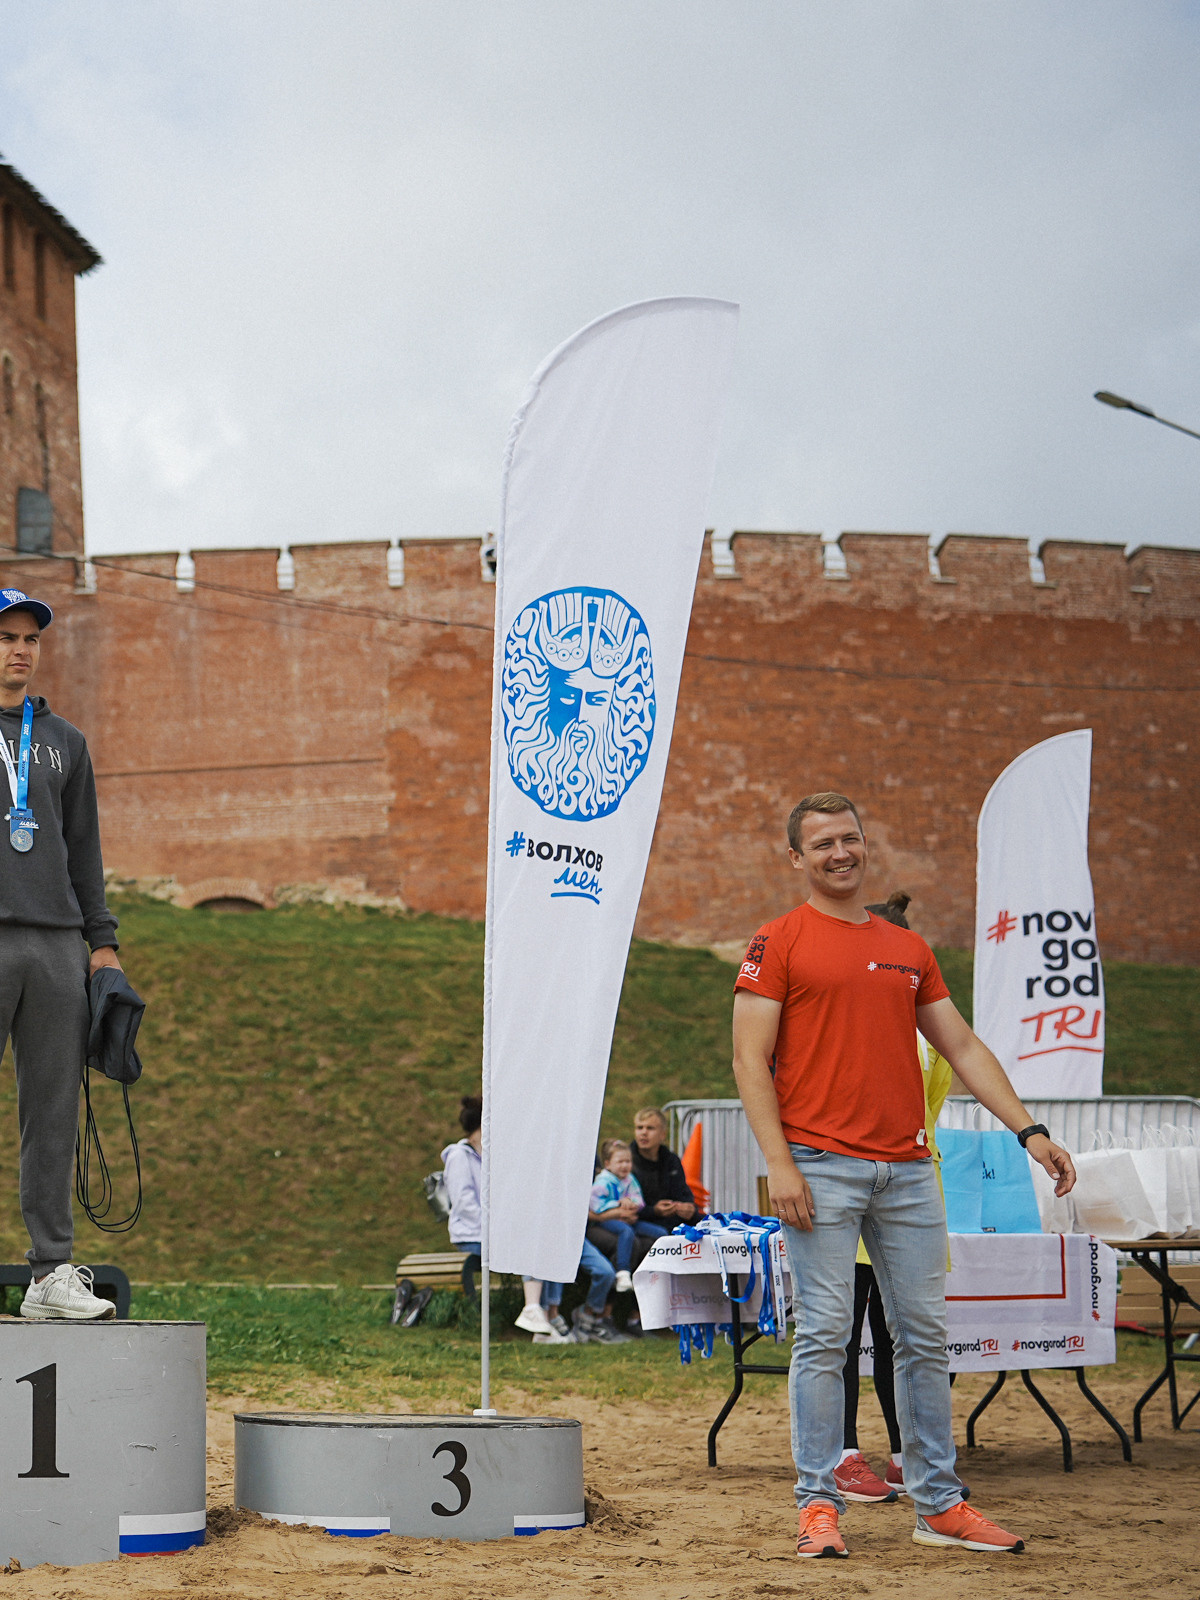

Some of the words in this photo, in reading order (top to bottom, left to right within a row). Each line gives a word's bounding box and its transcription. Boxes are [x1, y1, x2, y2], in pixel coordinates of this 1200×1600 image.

[986, 909, 1092, 944] #nov
[1042, 938, 1096, 971] go
[1026, 962, 1099, 999] rod
[1021, 1005, 1101, 1042] TRI
[16, 1362, 70, 1478] 1
[431, 1440, 472, 1517] 3
